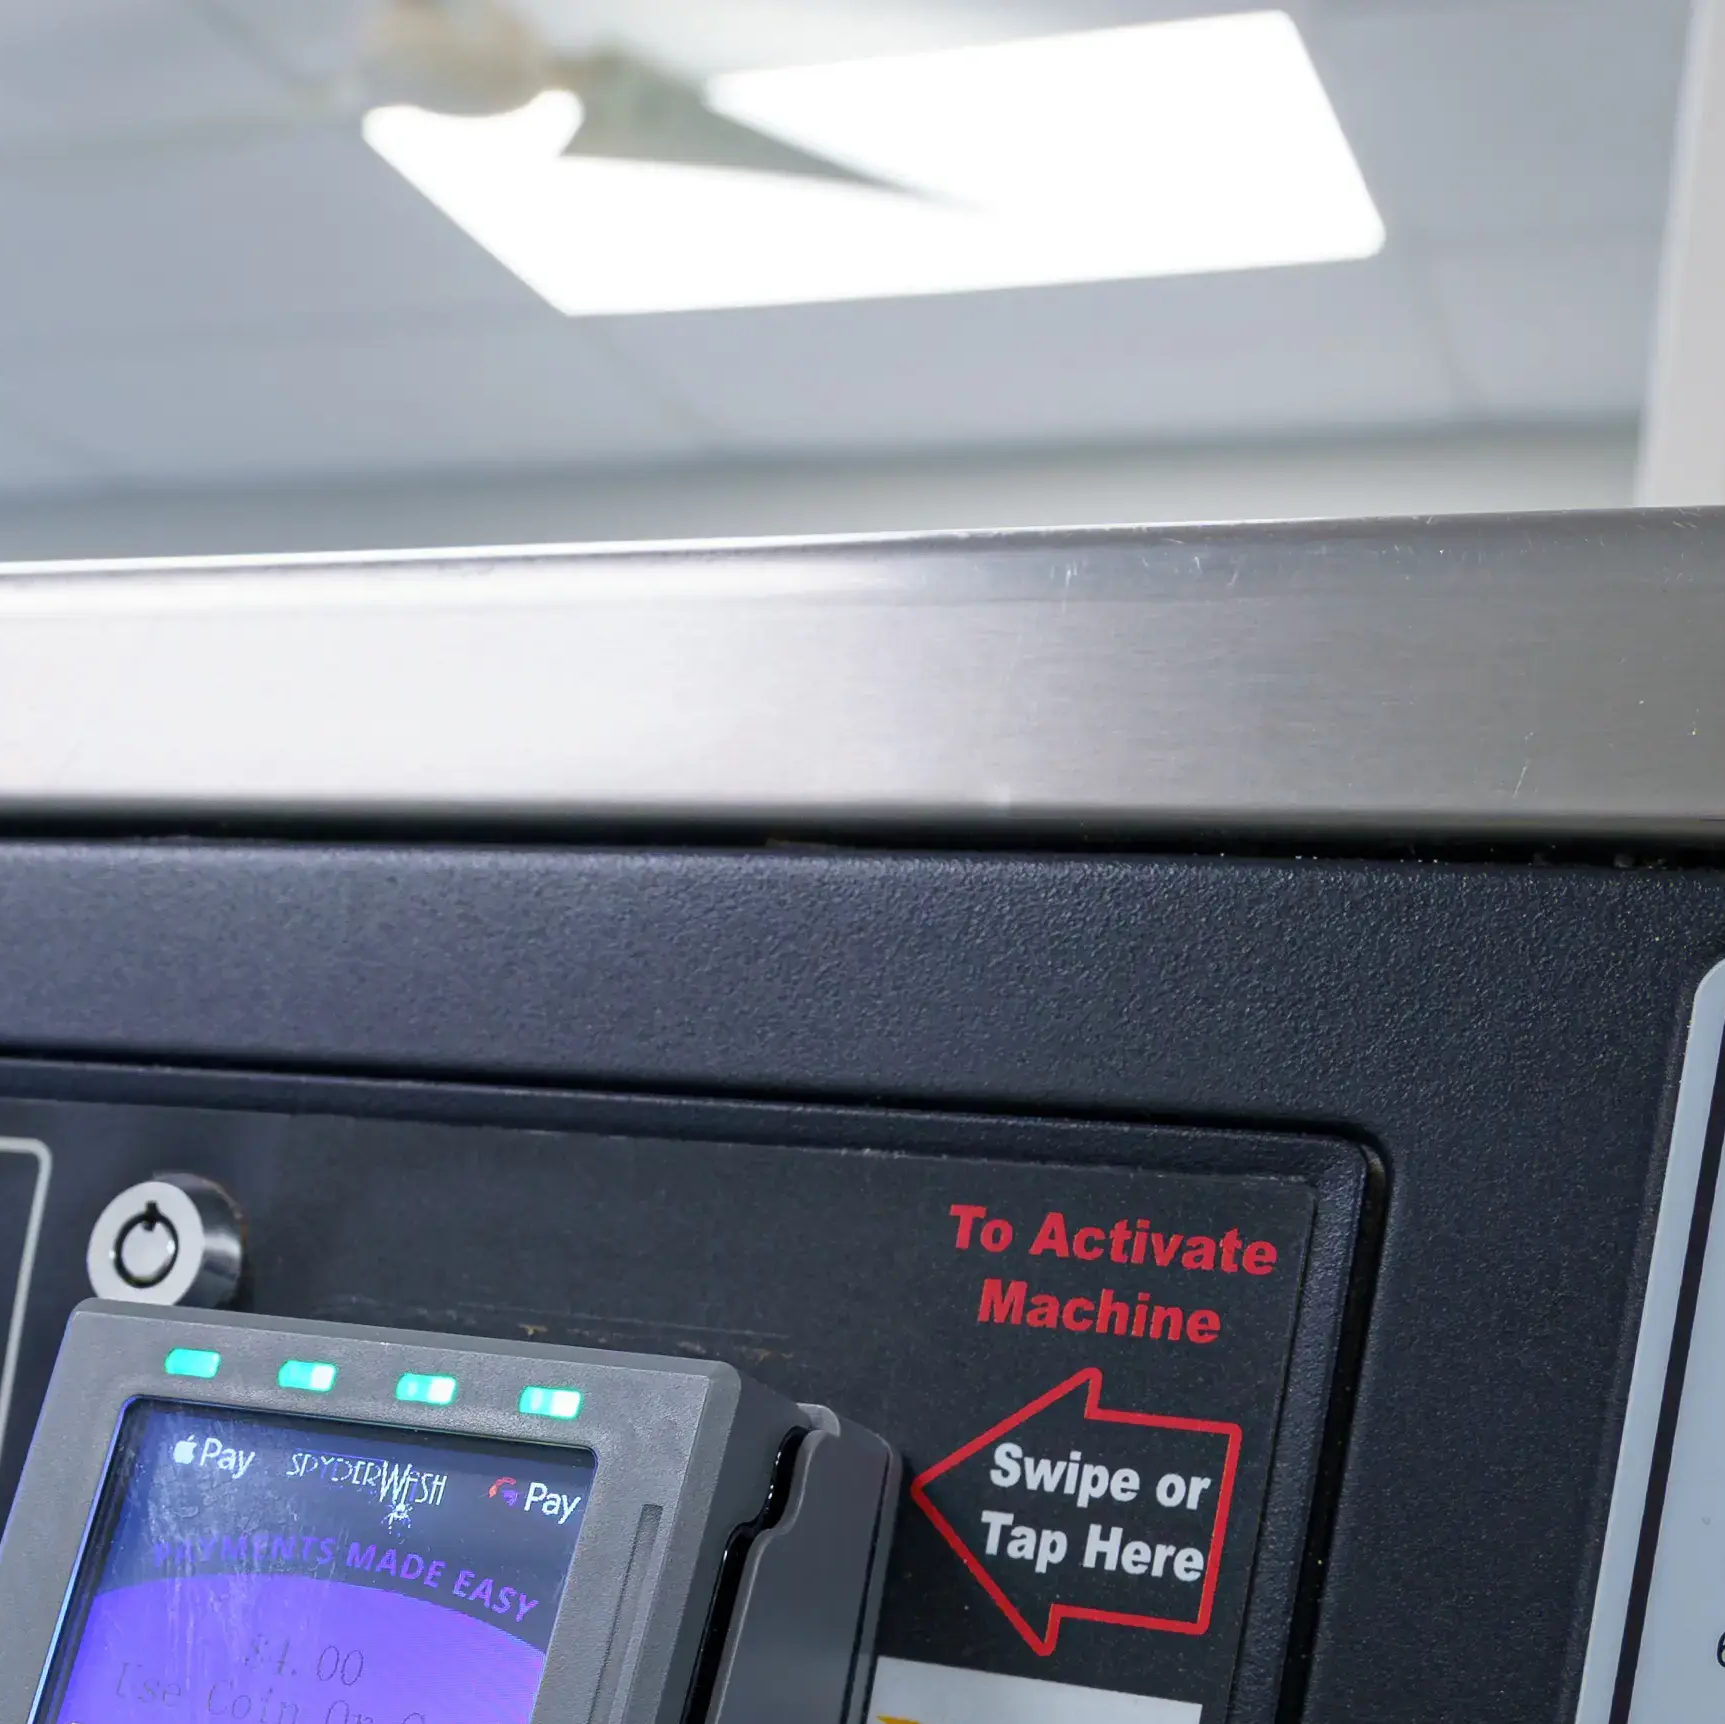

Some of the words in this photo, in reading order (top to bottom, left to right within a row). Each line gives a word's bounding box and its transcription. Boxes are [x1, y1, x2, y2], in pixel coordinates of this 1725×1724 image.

[949, 1204, 1014, 1254] To
[1029, 1211, 1278, 1276] Activate
[978, 1278, 1222, 1345] Machine
[200, 1438, 256, 1479] Pay
[990, 1442, 1141, 1508] Swipe
[1156, 1474, 1212, 1511] or
[523, 1482, 582, 1524] Pay
[153, 1532, 337, 1569] PAYMENTS
[345, 1541, 447, 1589] MADE
[452, 1569, 539, 1623] EASY
[980, 1510, 1068, 1574] Tap
[1082, 1524, 1205, 1583] Here
